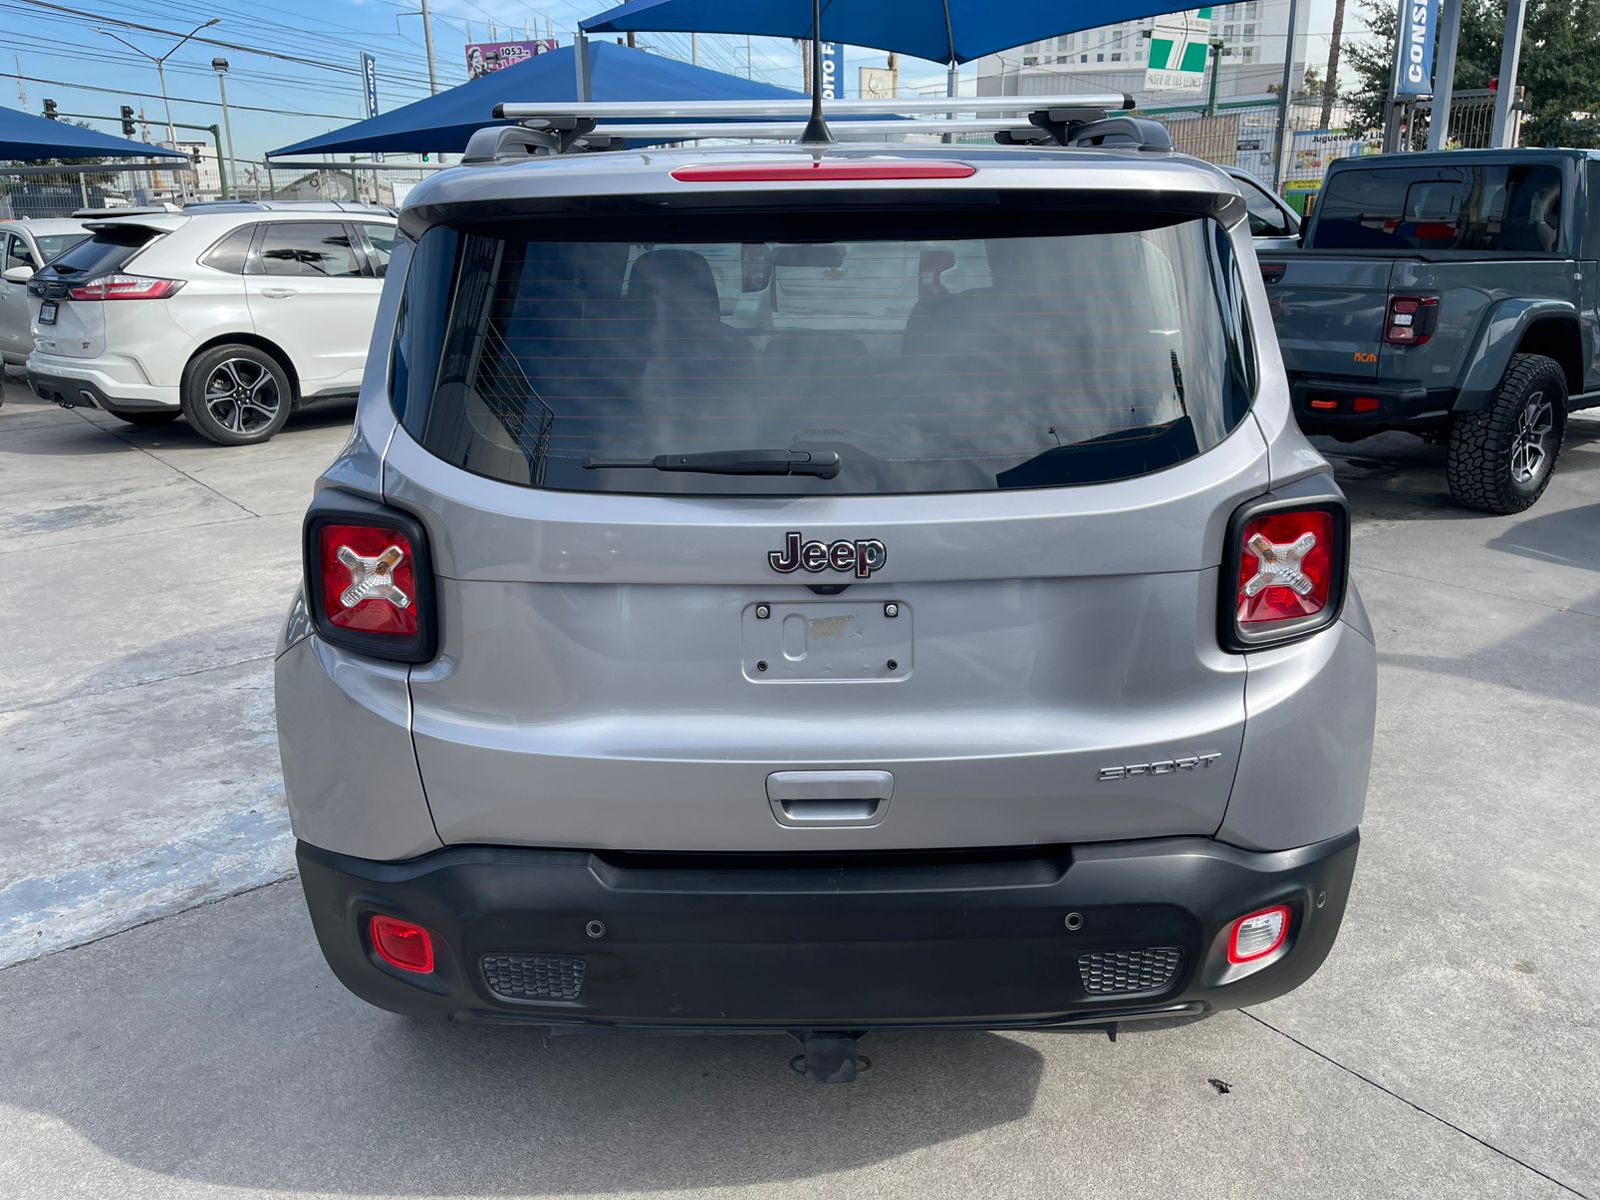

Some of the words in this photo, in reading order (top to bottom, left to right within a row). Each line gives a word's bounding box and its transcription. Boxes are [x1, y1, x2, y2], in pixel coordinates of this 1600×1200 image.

[367, 59, 375, 92] AUTO
[768, 531, 888, 579] Jeep
[1098, 751, 1222, 781] SPORT
